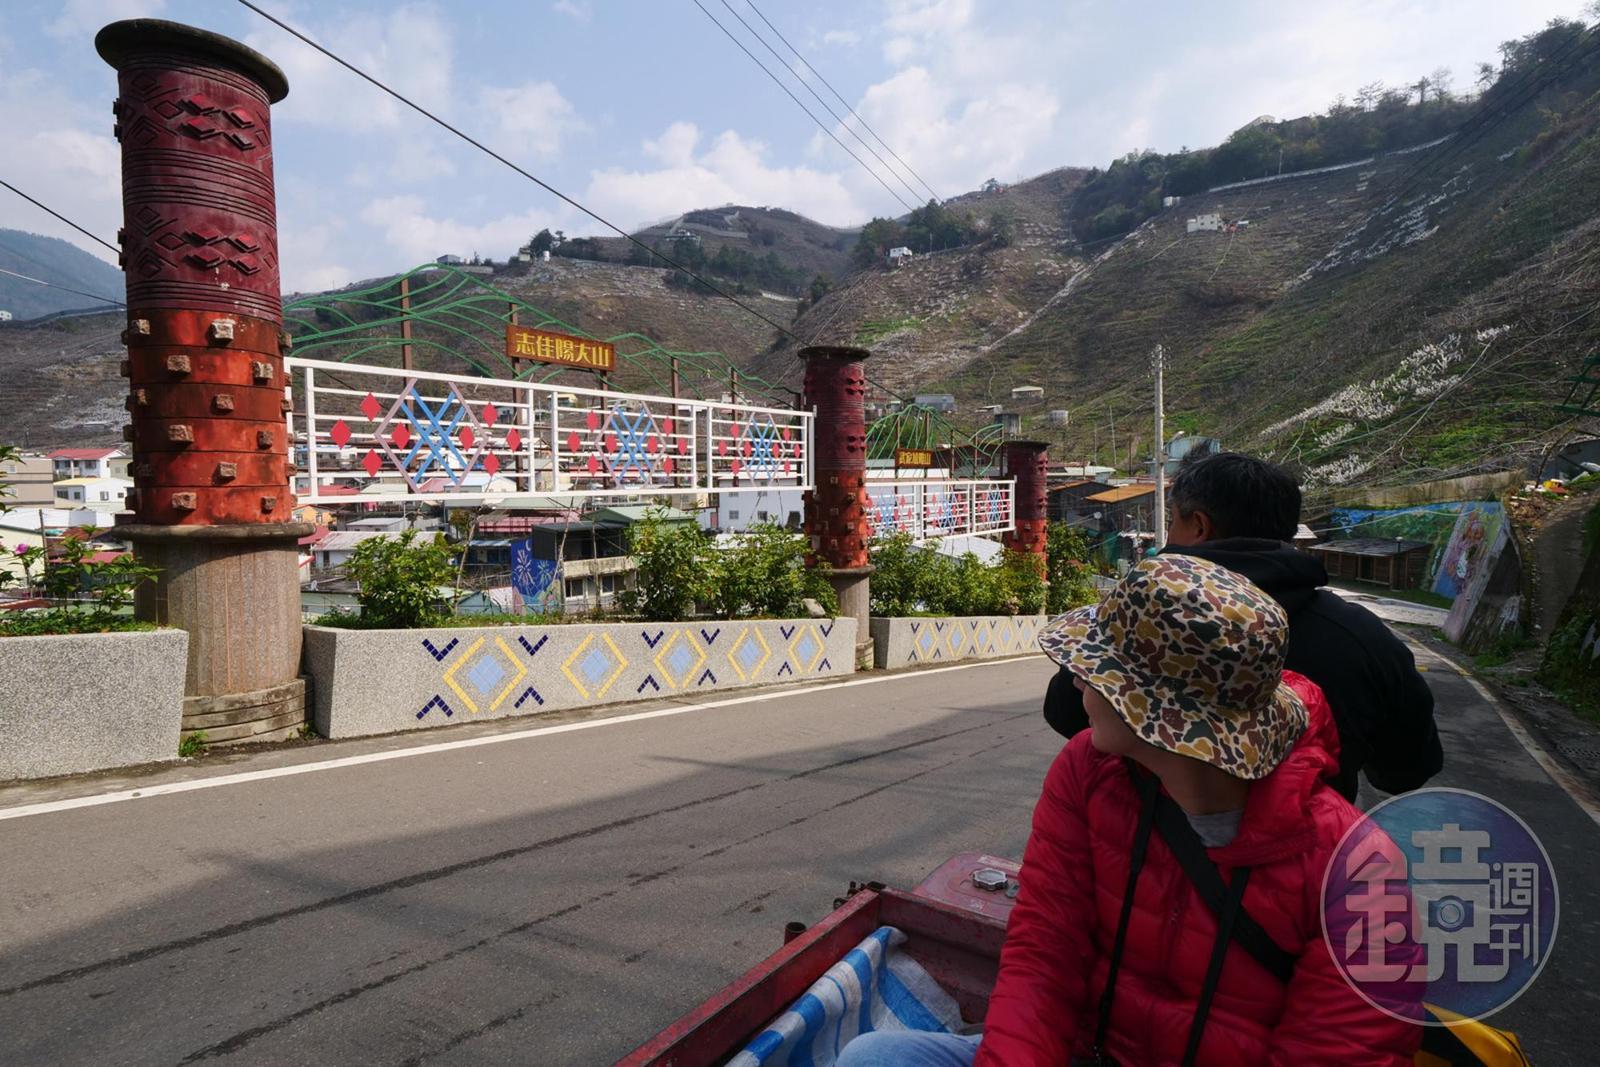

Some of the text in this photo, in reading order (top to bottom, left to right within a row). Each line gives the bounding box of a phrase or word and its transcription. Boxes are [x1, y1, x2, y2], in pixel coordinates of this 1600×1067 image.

[515, 332, 609, 367] 志佳陽大山
